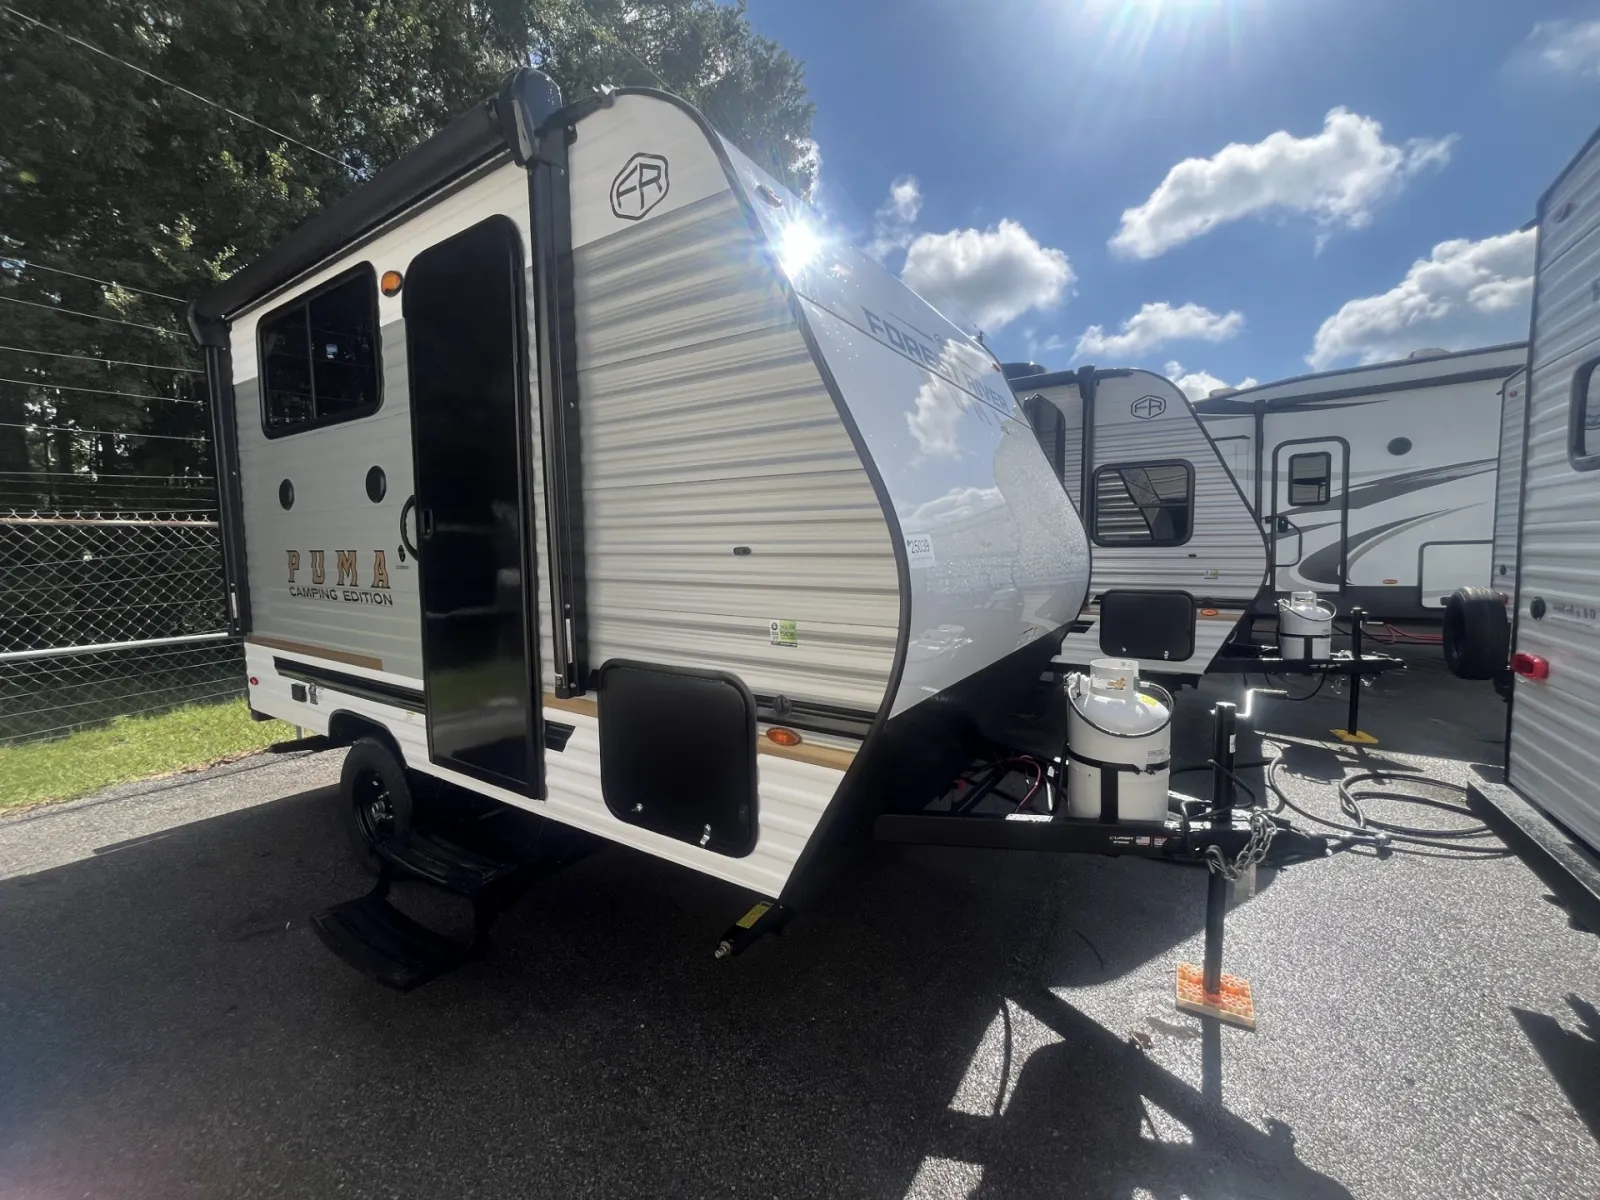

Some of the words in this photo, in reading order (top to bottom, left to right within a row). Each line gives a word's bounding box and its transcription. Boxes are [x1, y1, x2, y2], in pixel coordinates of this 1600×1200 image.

[616, 162, 662, 210] FR
[1134, 398, 1163, 416] FR
[286, 550, 391, 589] PUMA
[289, 586, 338, 600] CAMPING
[343, 590, 393, 606] EDITION
